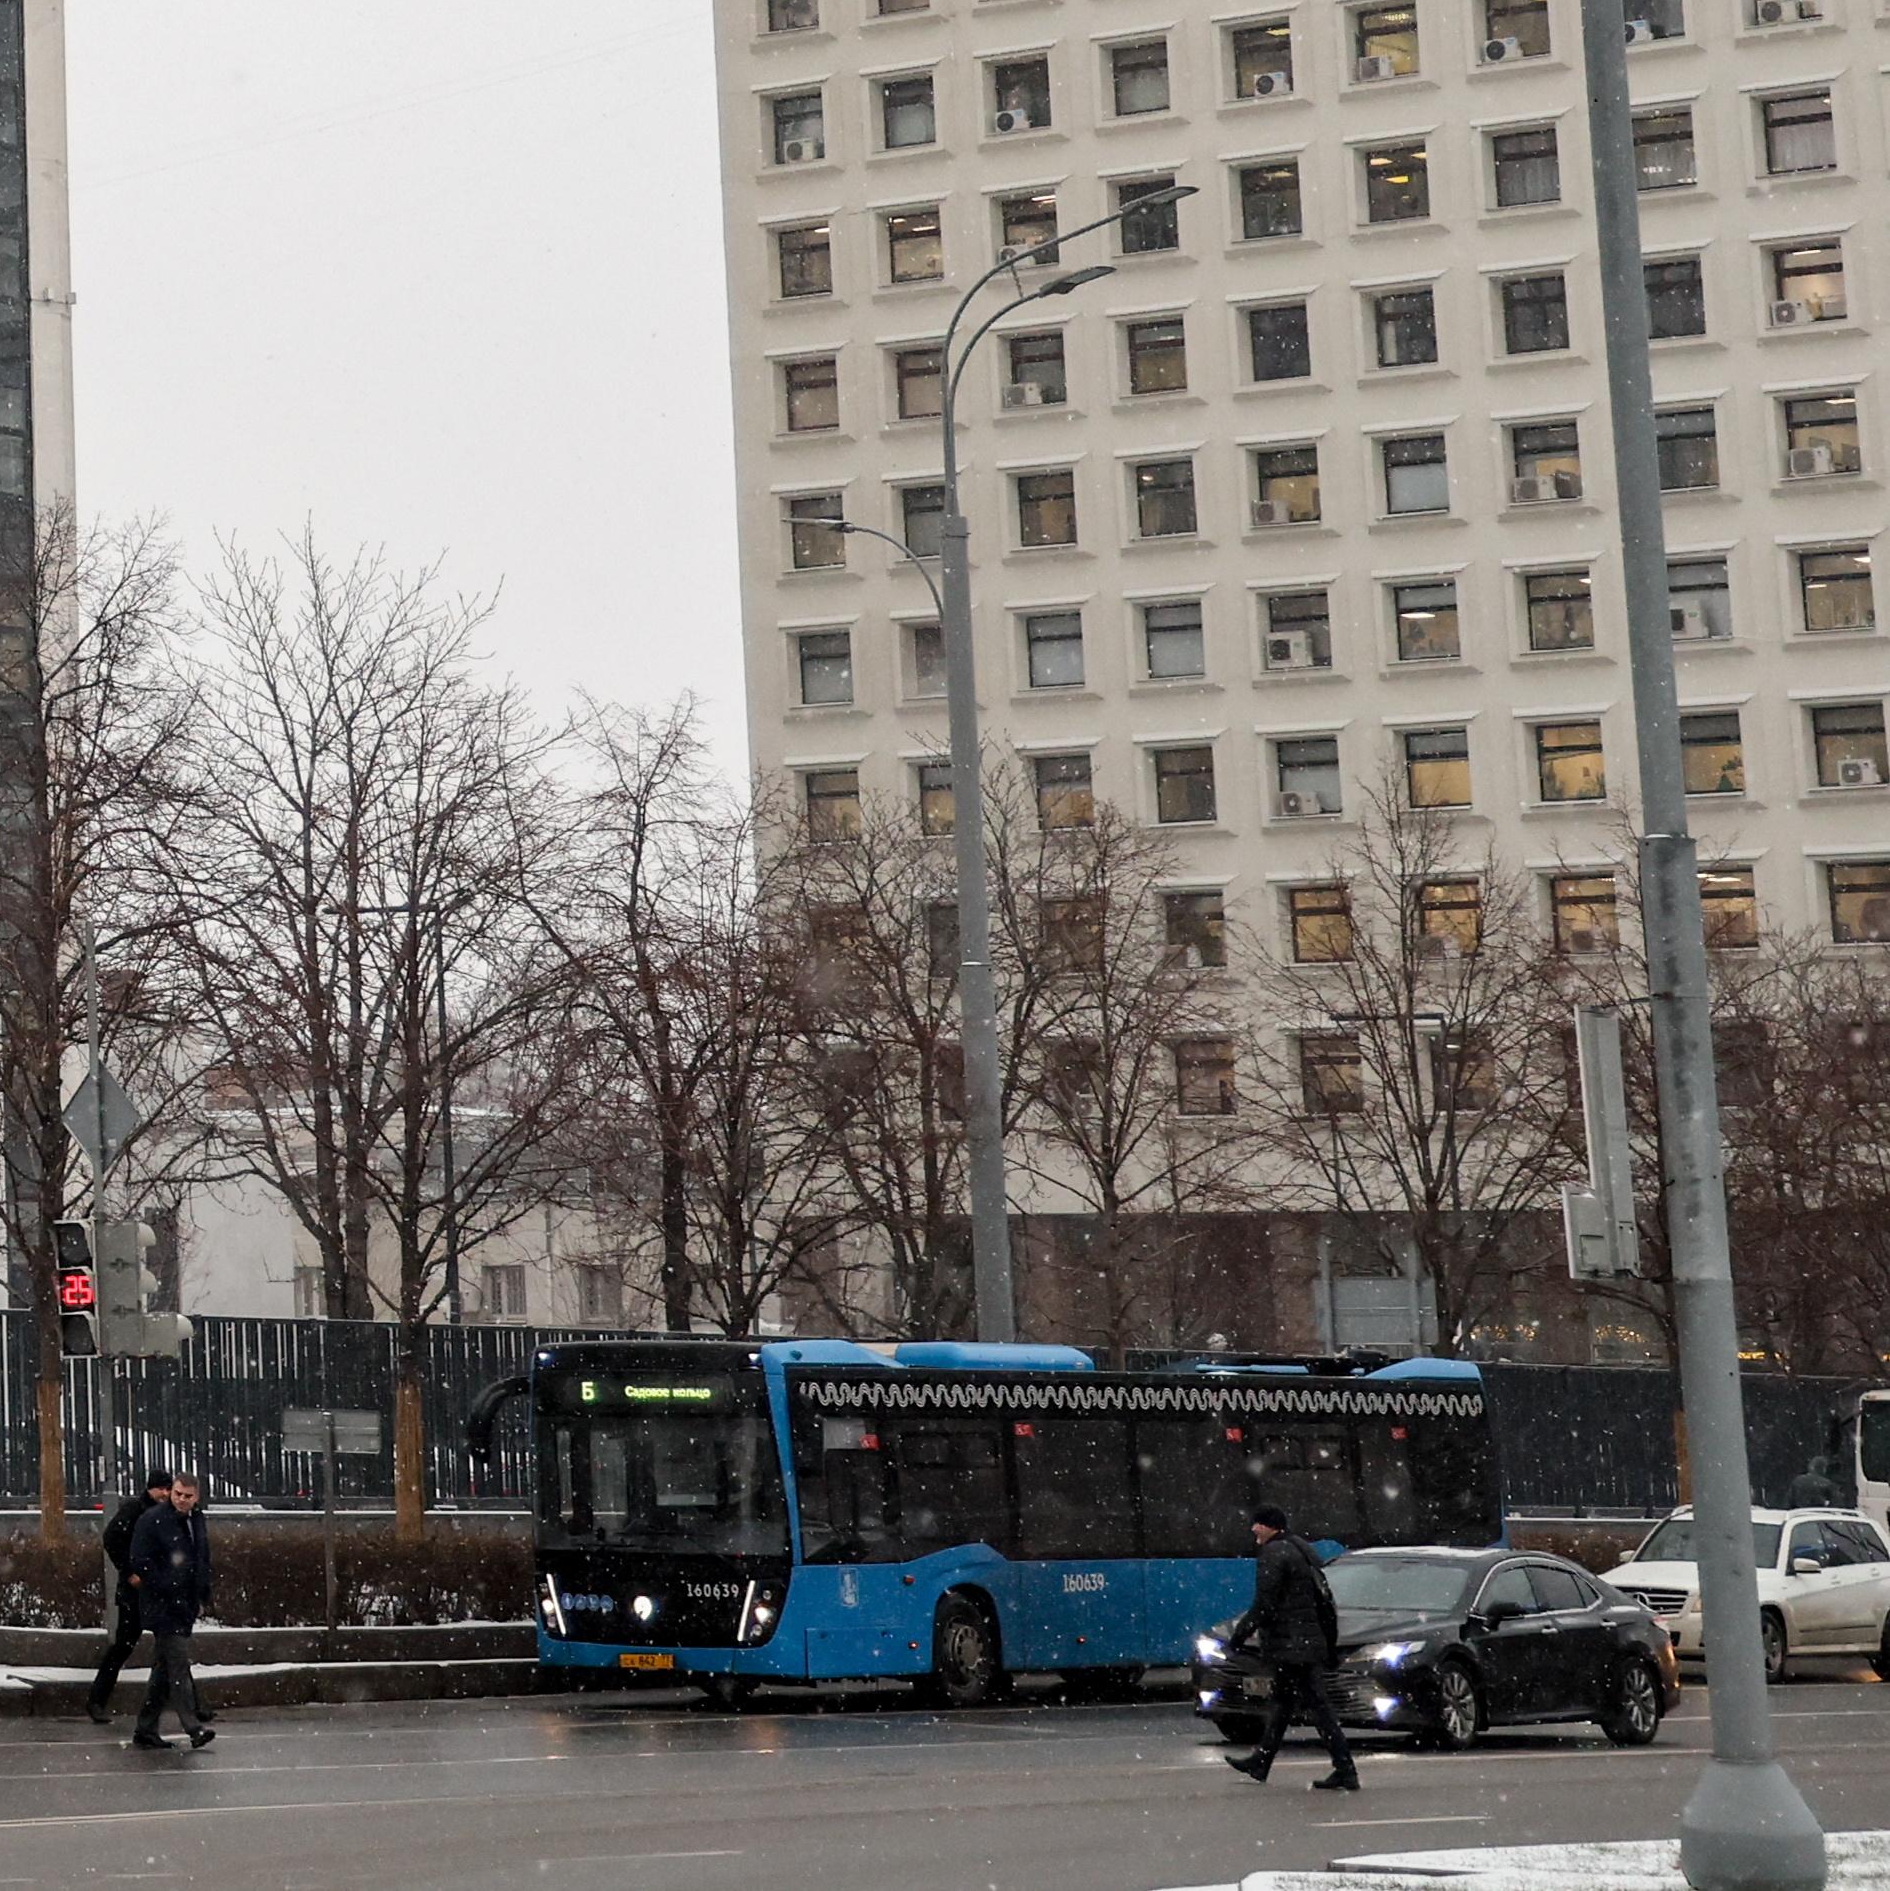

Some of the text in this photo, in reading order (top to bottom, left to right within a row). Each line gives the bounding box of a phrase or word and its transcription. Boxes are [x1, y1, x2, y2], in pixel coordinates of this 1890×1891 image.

[65, 1275, 93, 1305] 25
[581, 1381, 712, 1401] Б Садовое кольцо
[686, 1583, 740, 1598] 160639
[1062, 1574, 1105, 1592] 160639
